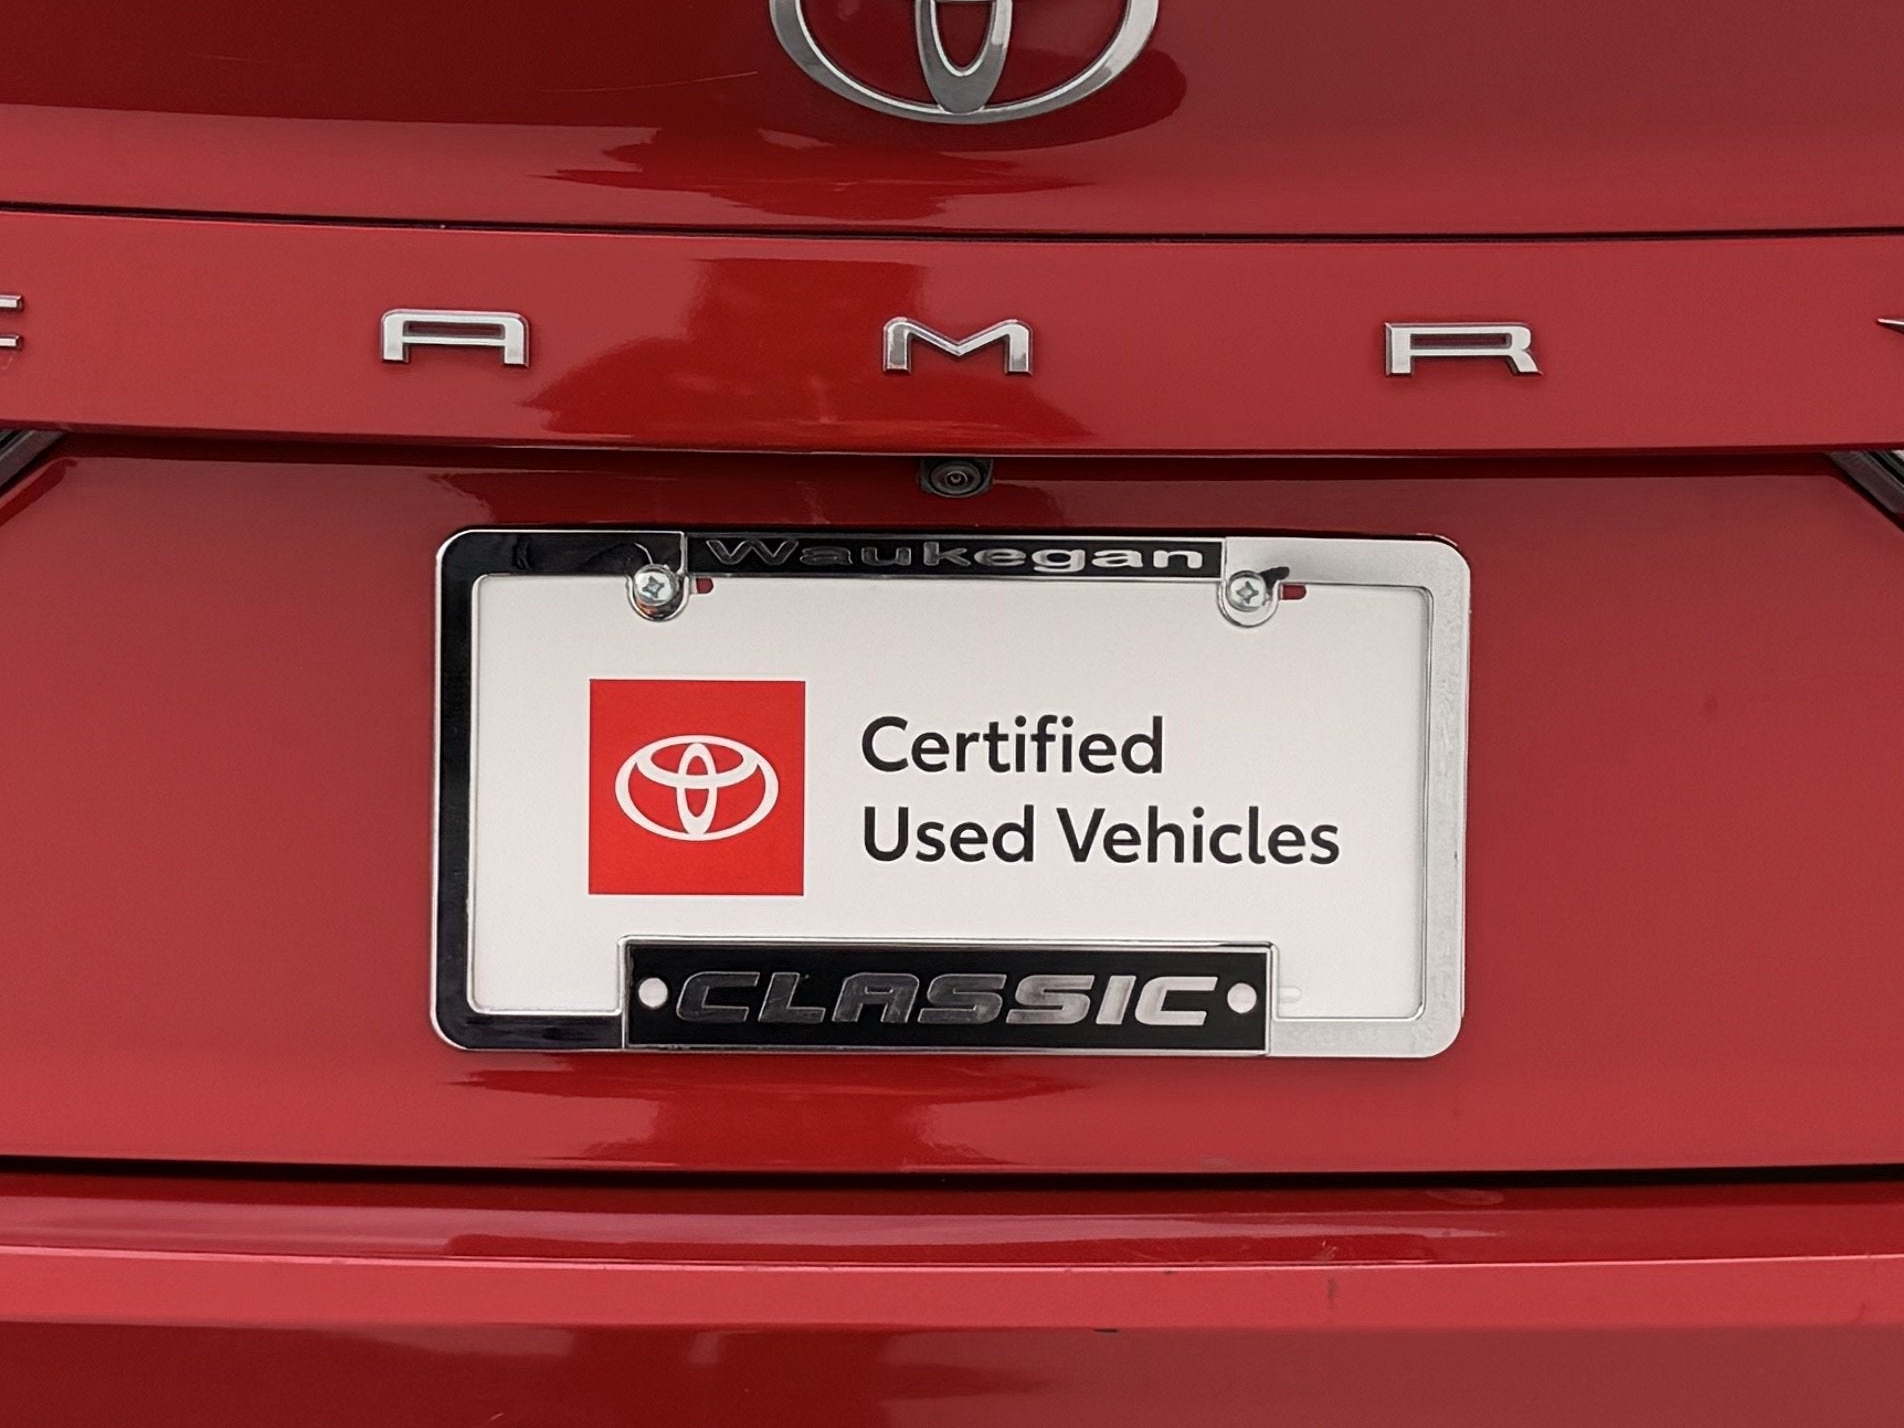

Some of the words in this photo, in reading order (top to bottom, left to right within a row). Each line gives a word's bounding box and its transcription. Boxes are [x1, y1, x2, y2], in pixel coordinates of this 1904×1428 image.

[705, 538, 1204, 572] Waukegan
[861, 714, 1164, 774] Certified
[863, 804, 1035, 863] Used
[1056, 805, 1341, 865] Vehicles
[675, 972, 1219, 1026] CLASSIC
